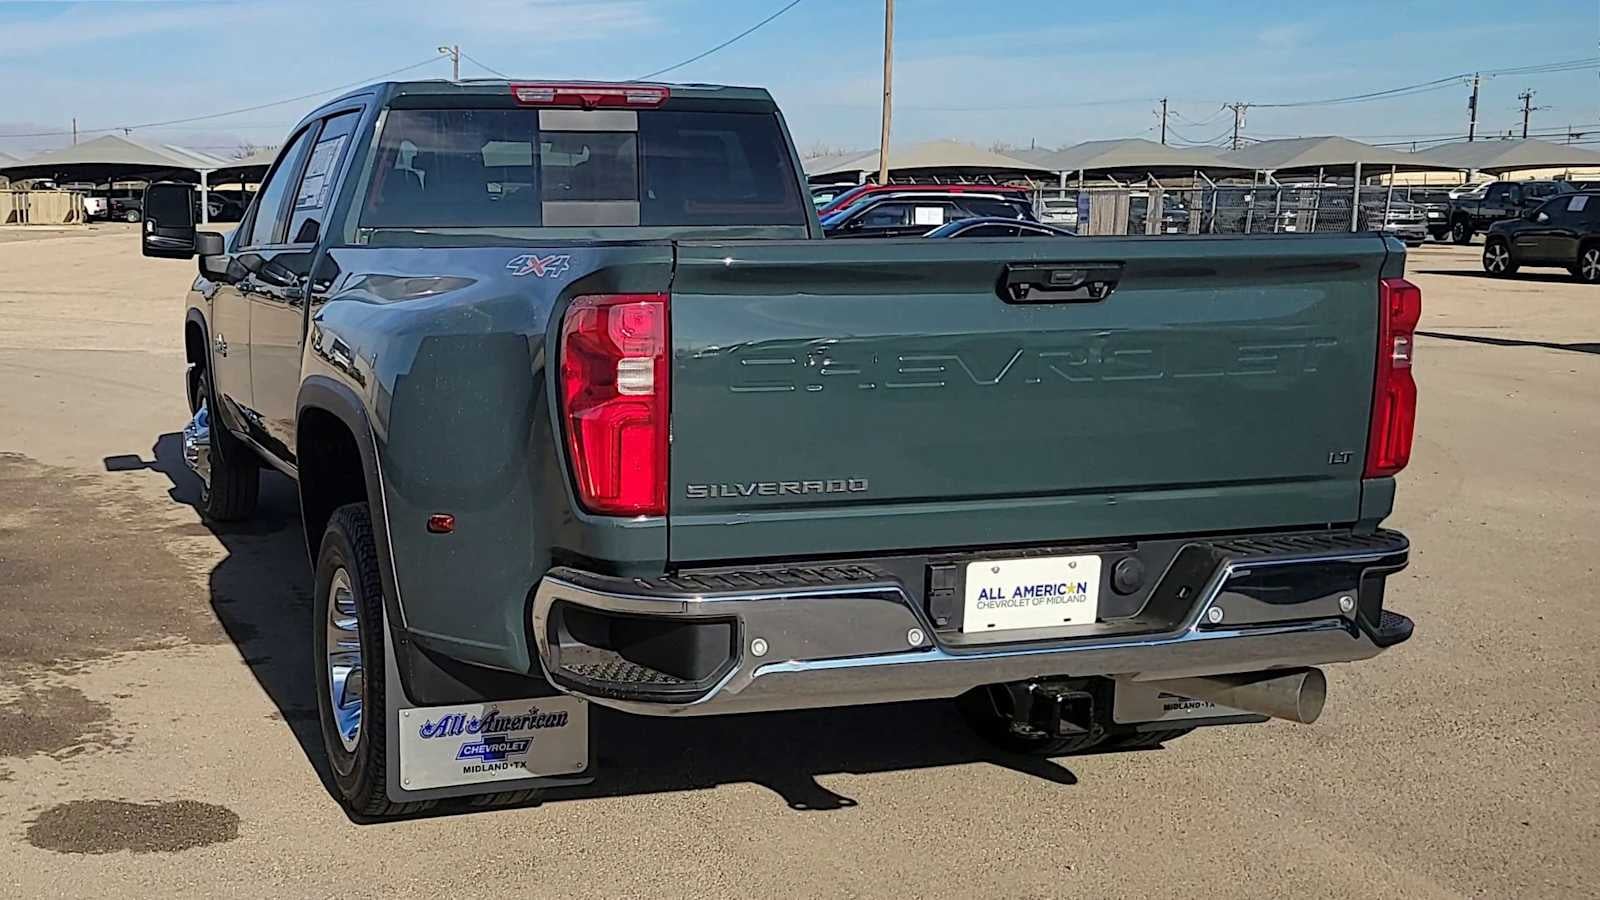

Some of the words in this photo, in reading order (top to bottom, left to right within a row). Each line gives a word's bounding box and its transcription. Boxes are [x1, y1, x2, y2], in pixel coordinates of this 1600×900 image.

[1328, 450, 1352, 465] LT
[686, 478, 869, 499] SILVERADO
[976, 598, 1031, 610] CHEVROLET
[1032, 597, 1046, 606] OF
[1047, 593, 1087, 605] MIDLAND
[978, 587, 1005, 600] ALL
[466, 706, 568, 733] American
[463, 741, 526, 755] CHEVROLET
